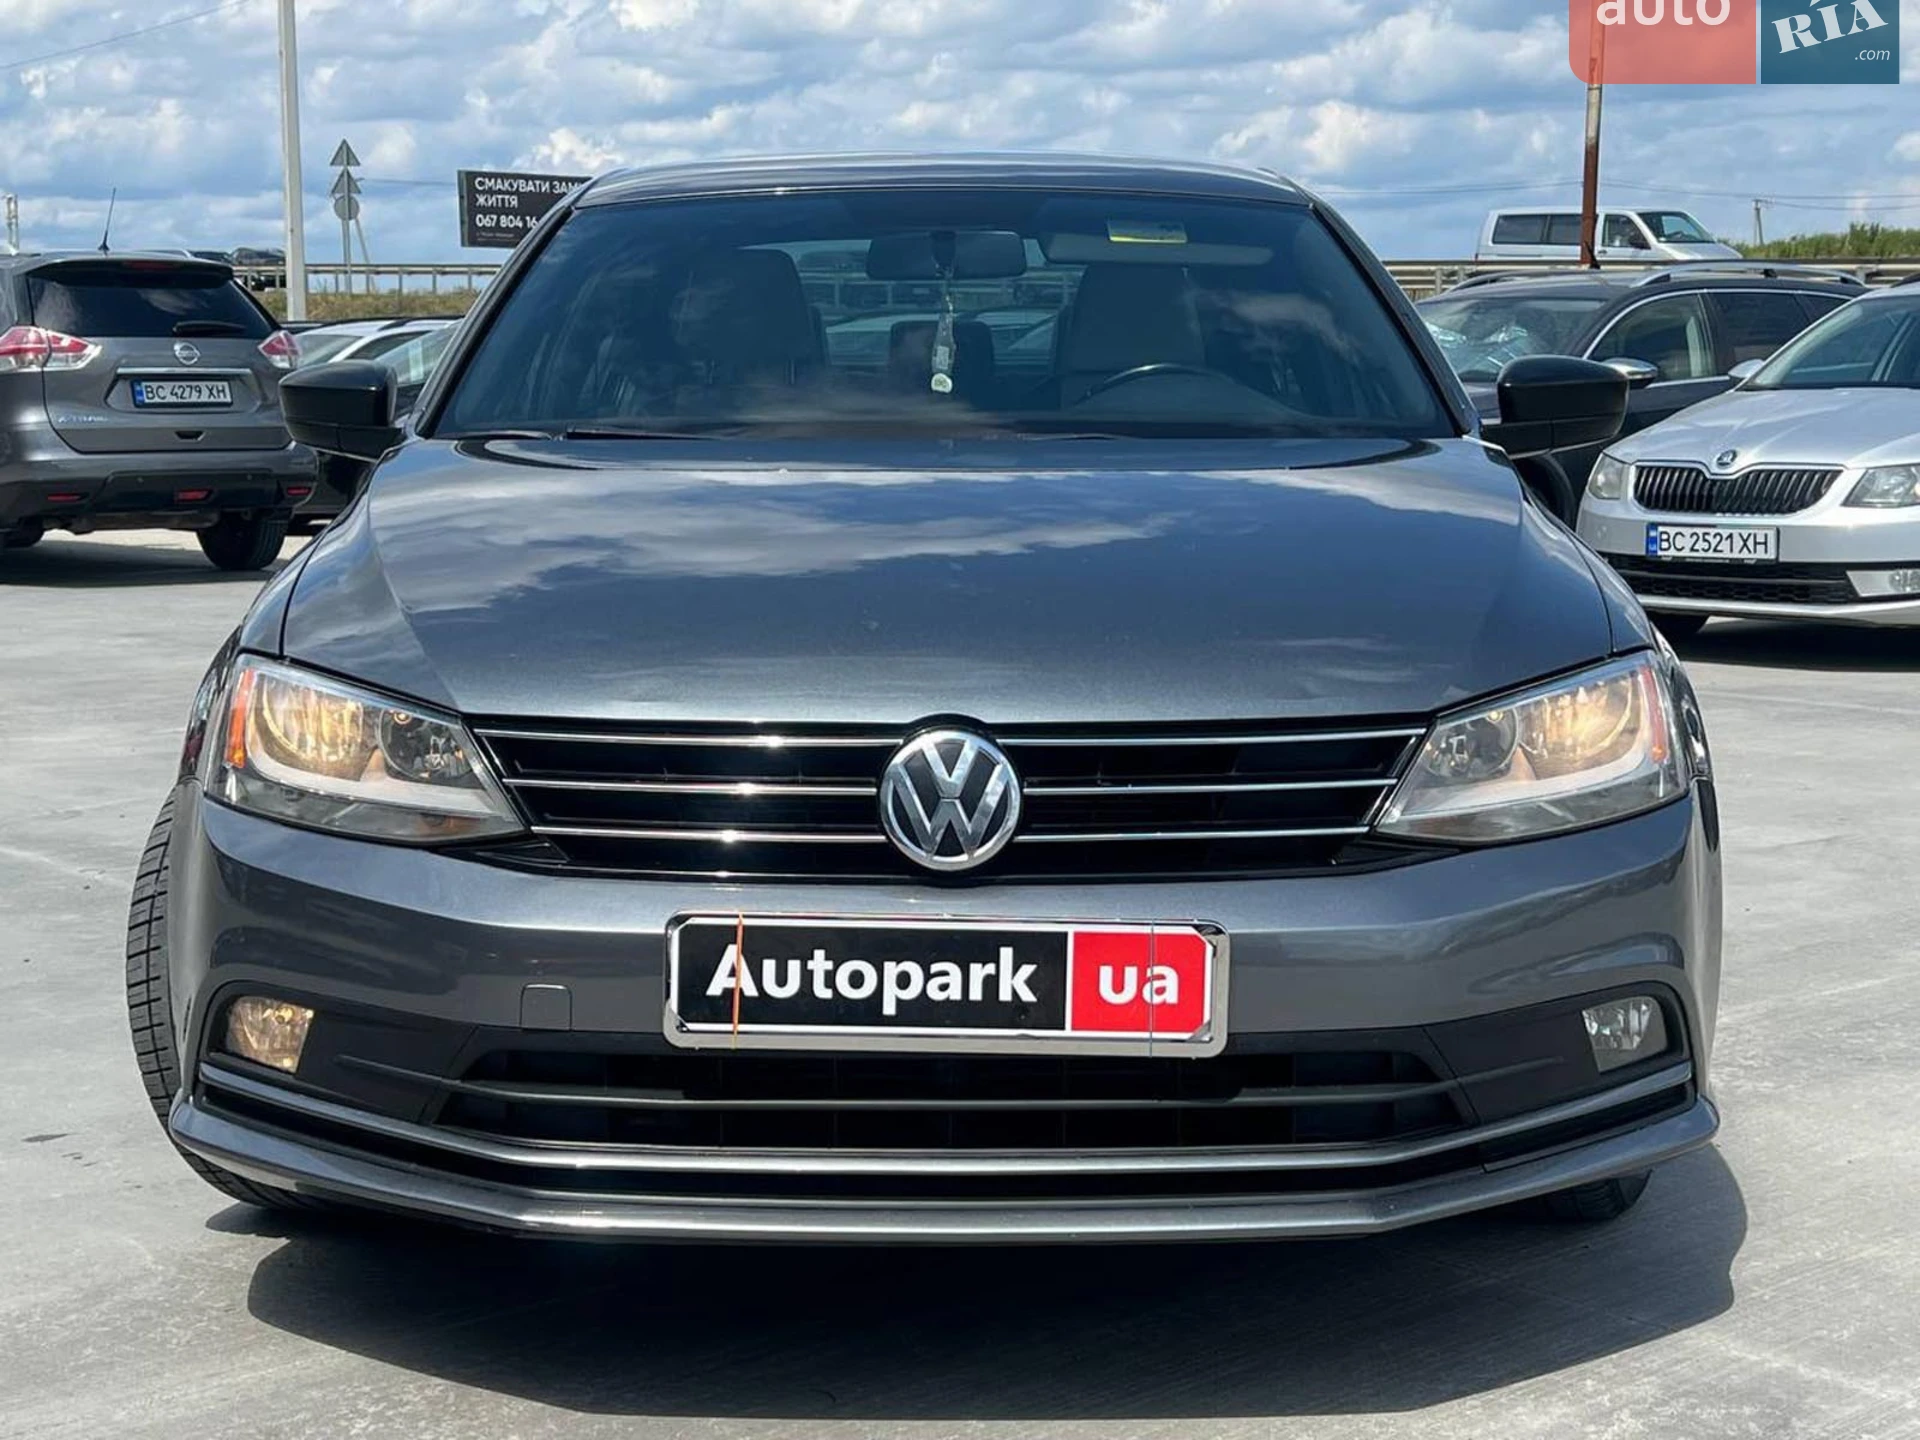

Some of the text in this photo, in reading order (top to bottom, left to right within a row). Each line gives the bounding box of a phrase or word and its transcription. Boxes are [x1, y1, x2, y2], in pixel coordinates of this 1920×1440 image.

[475, 177, 550, 193] СМАКУВАТИ
[475, 194, 518, 208] ЖИТТЯ
[475, 213, 497, 227] 067
[500, 214, 523, 228] 804
[145, 385, 227, 400] BC 4279 XH
[1659, 531, 1768, 554] BC 2521 XH
[705, 943, 1180, 1015] Autopark ua
